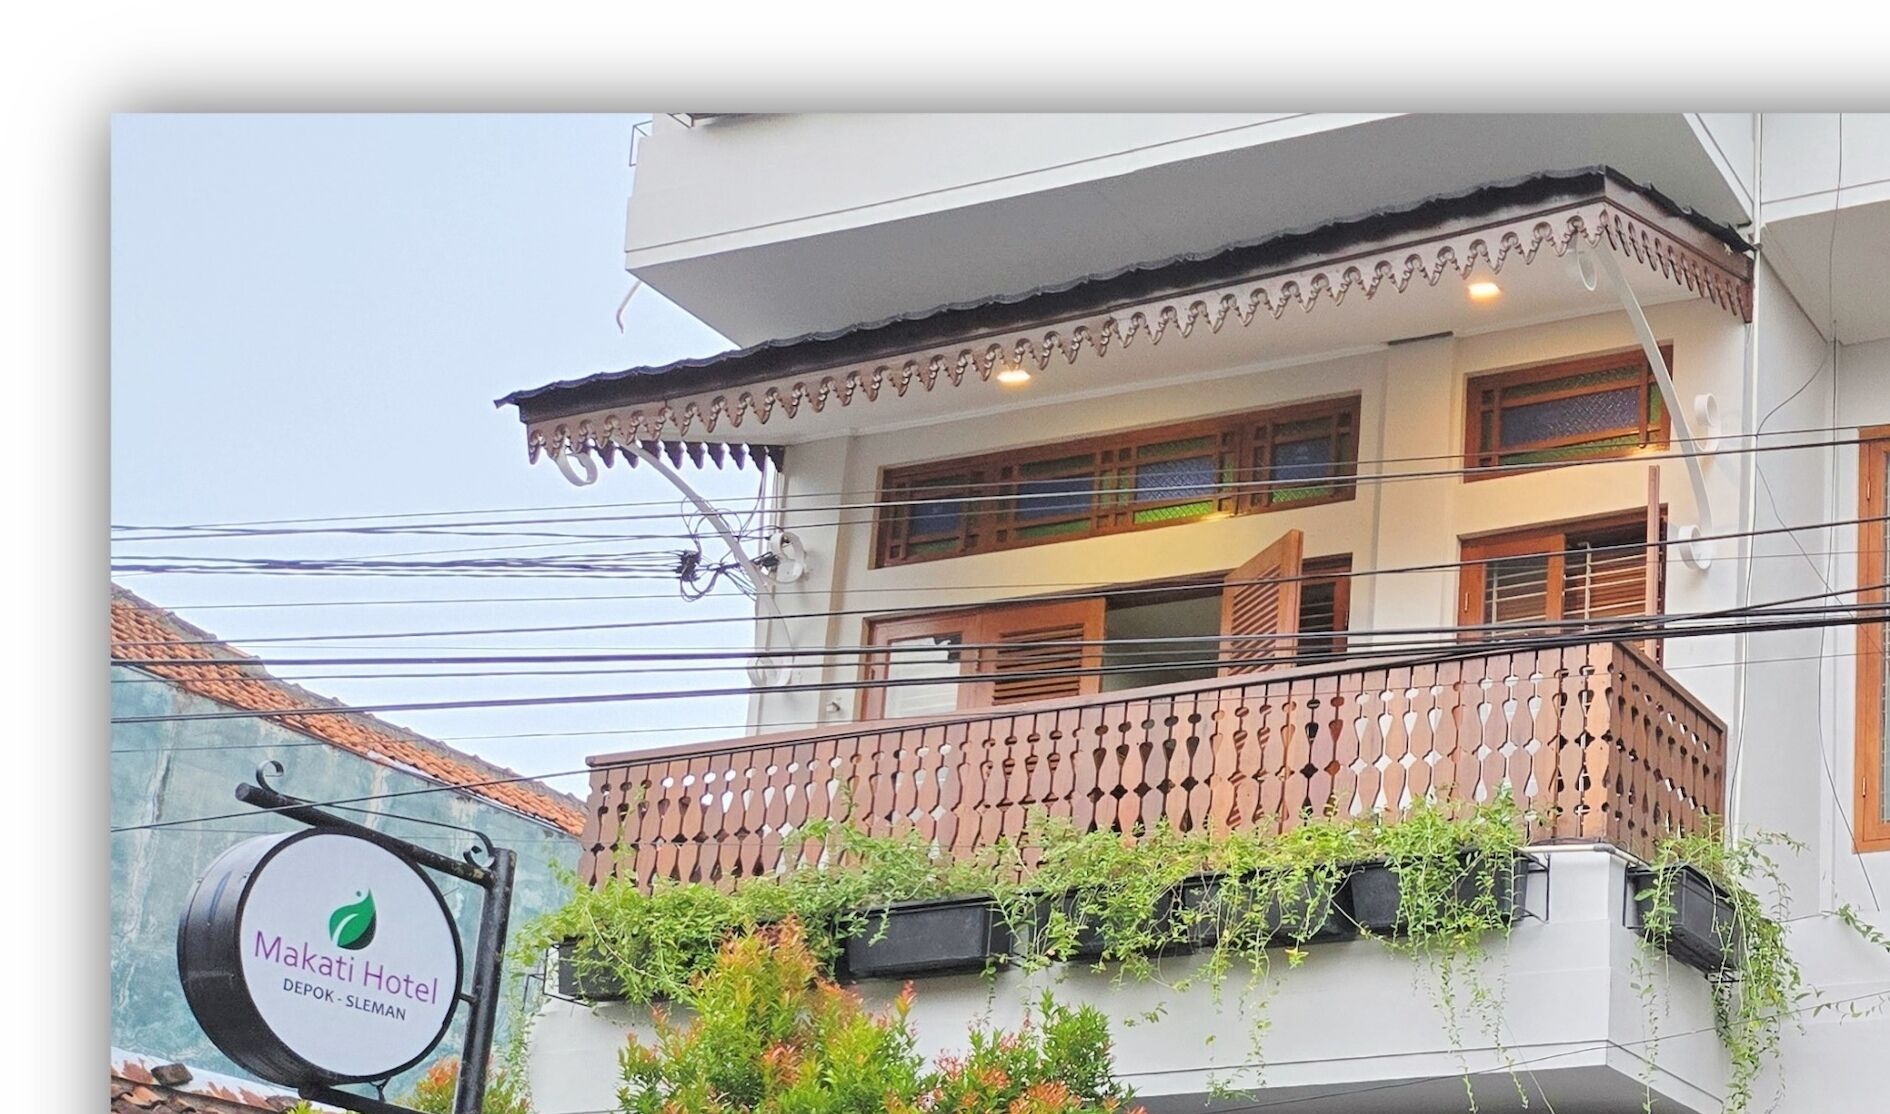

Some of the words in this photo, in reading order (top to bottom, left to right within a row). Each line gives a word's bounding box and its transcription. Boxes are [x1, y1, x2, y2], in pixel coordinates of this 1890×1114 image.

[254, 930, 355, 984] Makati
[363, 960, 438, 1005] Hotel
[283, 977, 335, 1003] DEPOK
[345, 995, 407, 1021] SLEMAN
